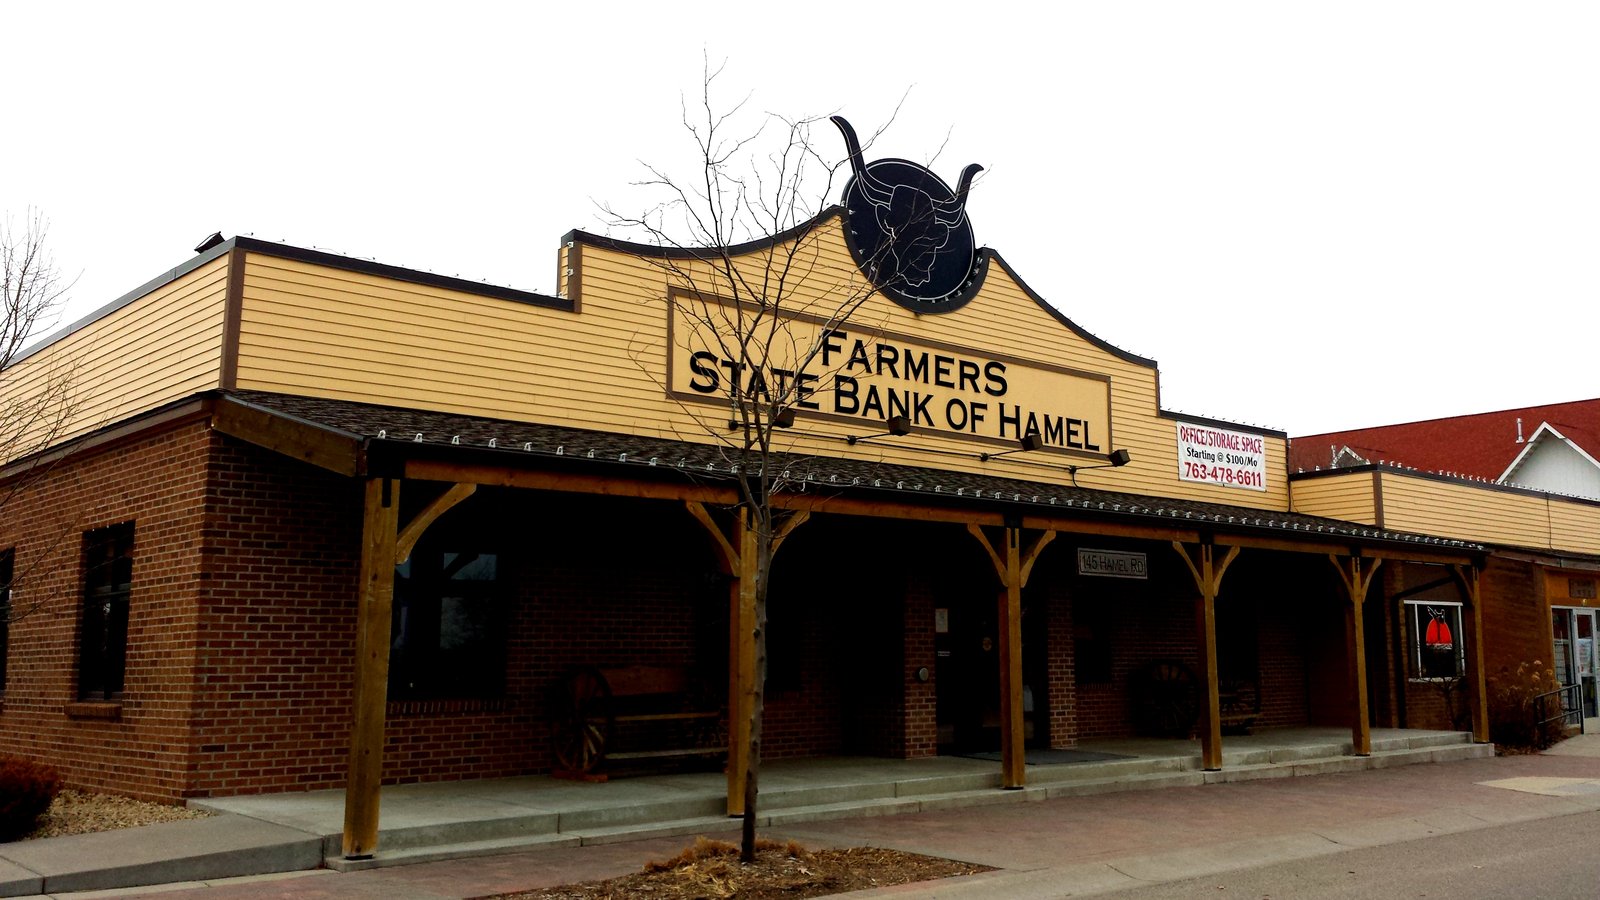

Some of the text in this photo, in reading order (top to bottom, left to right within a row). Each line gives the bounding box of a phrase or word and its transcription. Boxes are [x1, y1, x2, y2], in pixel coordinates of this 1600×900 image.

[821, 328, 1008, 397] FARMERS
[690, 351, 1100, 452] STATE BANK OF HAMEL
[1180, 425, 1262, 454] OFFICE/STORAGE SPACE
[1186, 446, 1258, 467] Starting @ $100/Mo
[1184, 461, 1262, 487] 763-478-6611
[1082, 554, 1098, 570] 145
[1099, 555, 1128, 572] HAMEL
